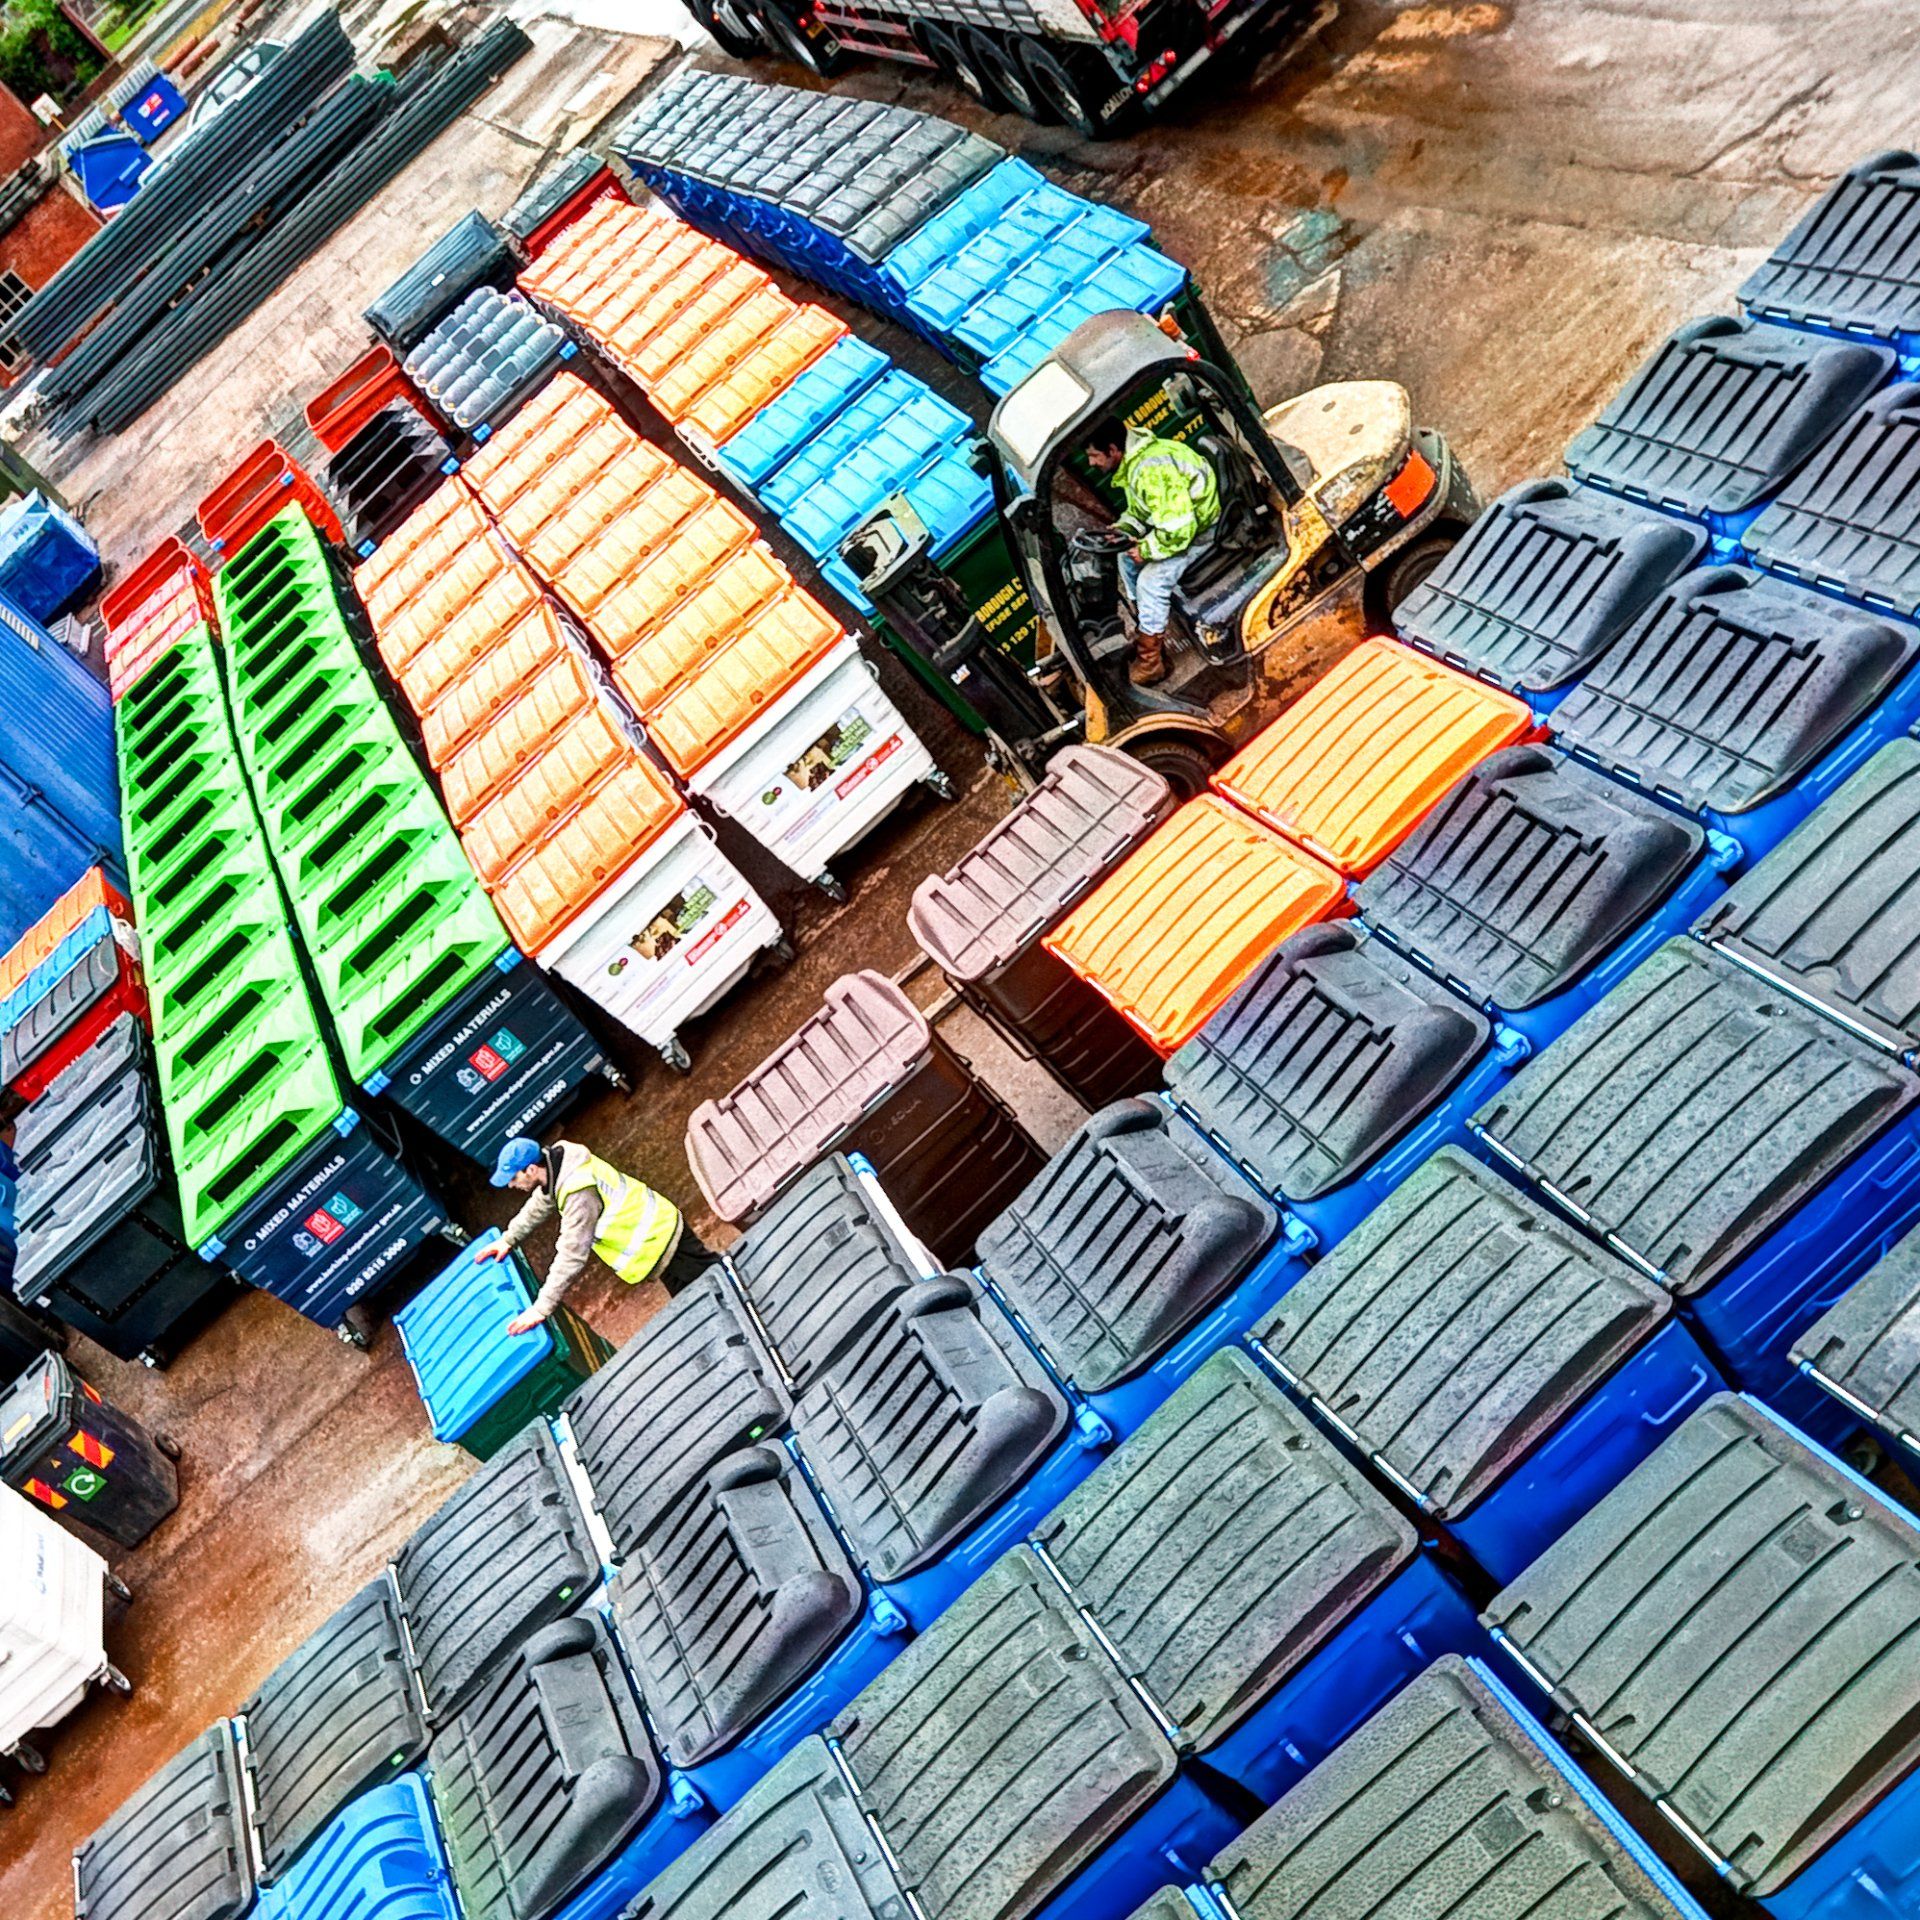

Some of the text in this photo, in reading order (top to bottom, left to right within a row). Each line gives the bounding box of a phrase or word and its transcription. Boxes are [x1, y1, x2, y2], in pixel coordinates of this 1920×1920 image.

[1133, 388, 1170, 422] BOROUG
[974, 584, 1015, 623] BOROUGH
[985, 606, 1013, 633] EFUSE
[950, 663, 971, 685] CAT
[421, 1042, 456, 1075] MIXED
[452, 988, 512, 1045] MATERIALS
[504, 1118, 525, 1138] 020
[543, 1079, 567, 1102] 3000
[255, 1208, 289, 1241] MIXED
[287, 1155, 345, 1211] MATERIALS
[305, 1202, 403, 1294] www.barking-dagenhamgov.uk
[345, 1275, 365, 1295] 020
[384, 1237, 407, 1261] 3000
